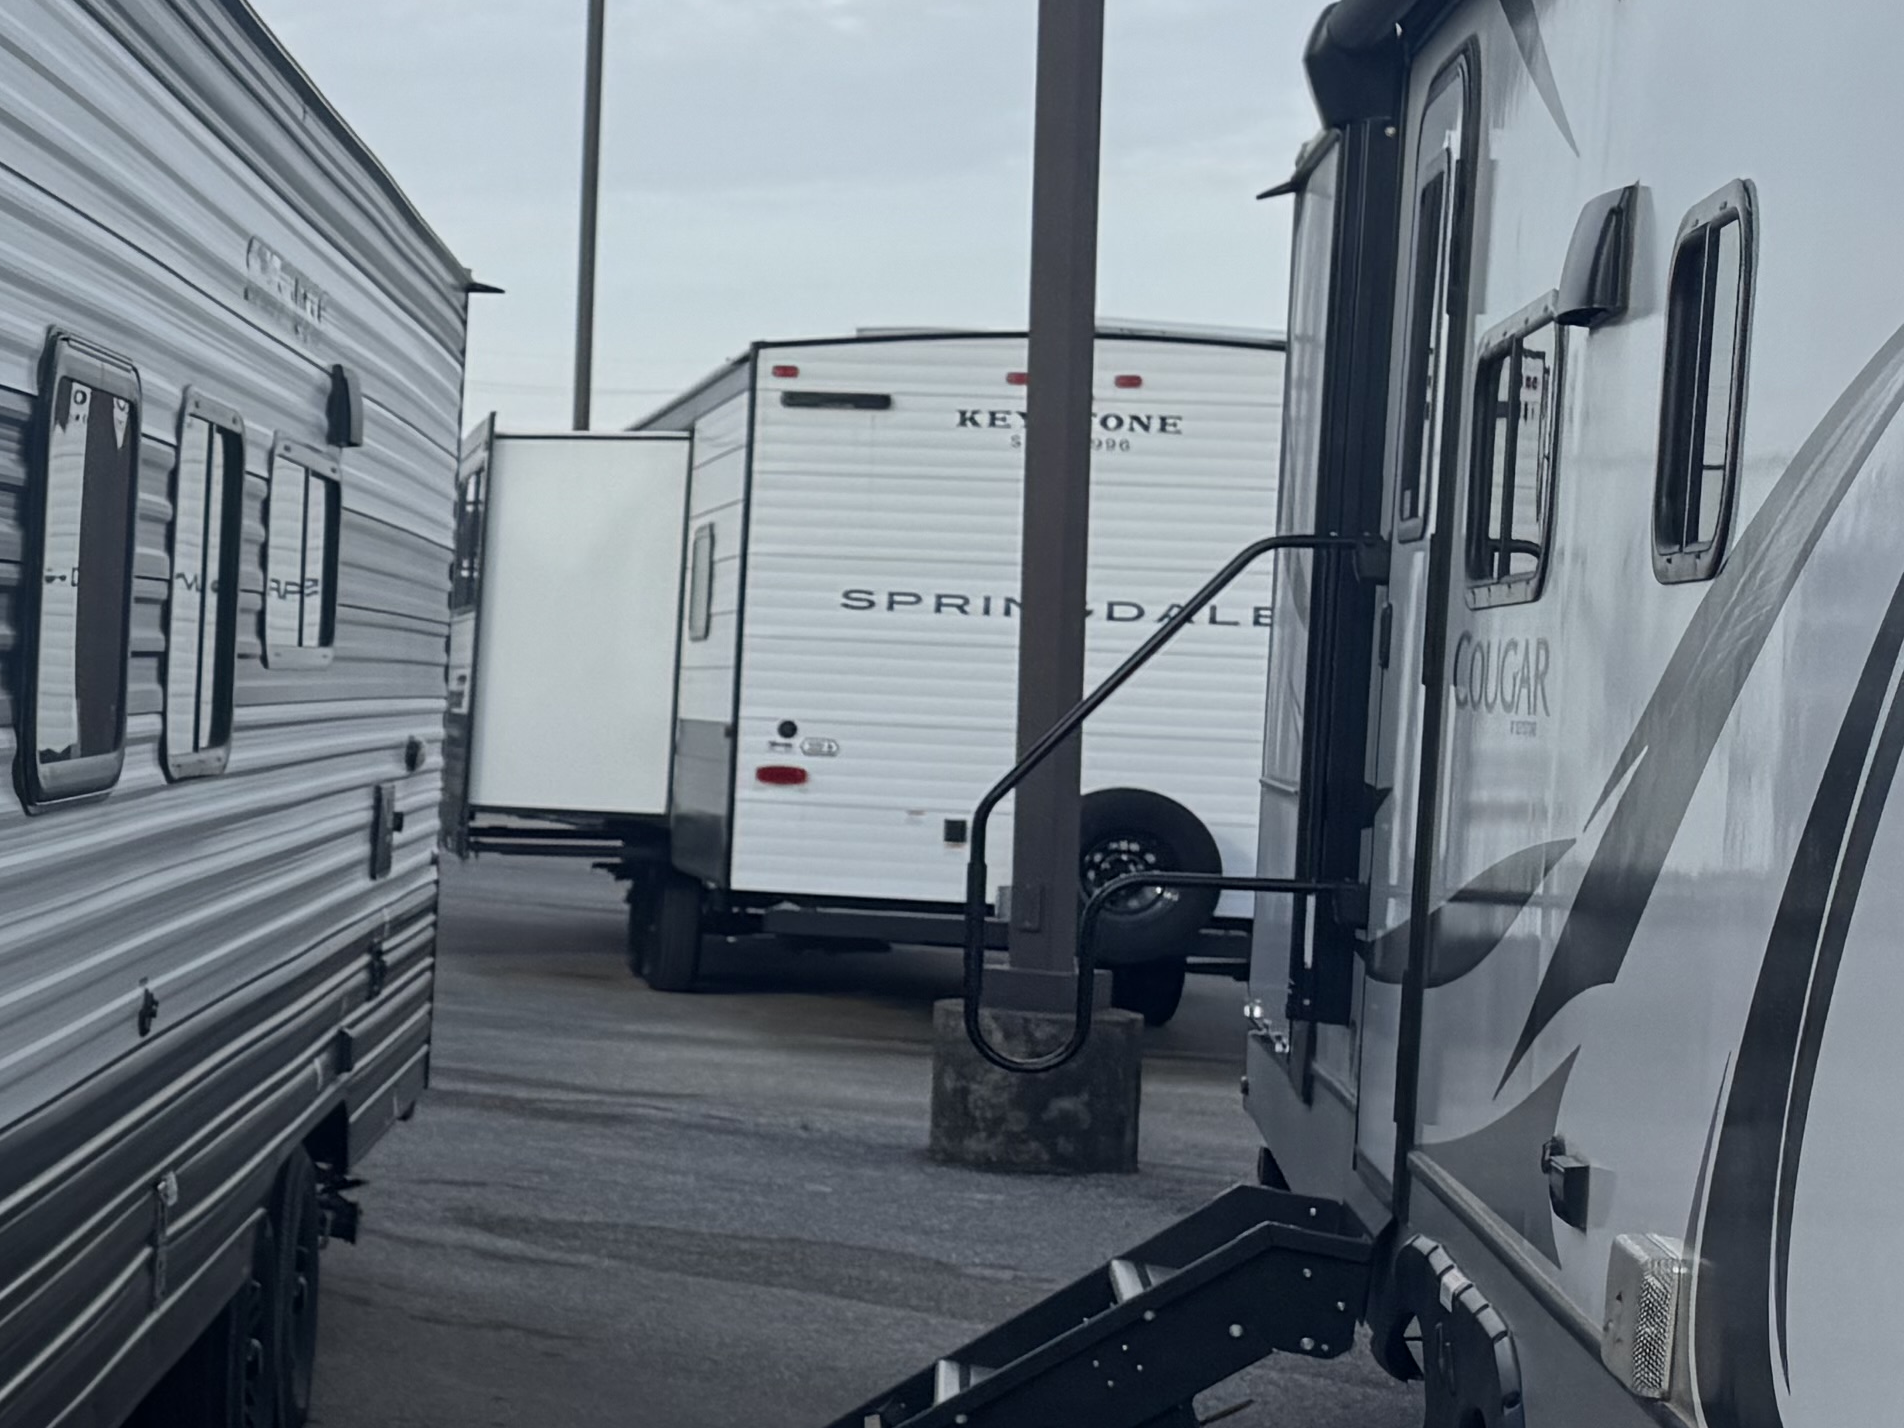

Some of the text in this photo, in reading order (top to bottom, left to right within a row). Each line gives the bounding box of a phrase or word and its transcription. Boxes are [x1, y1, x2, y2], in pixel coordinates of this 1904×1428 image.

[956, 409, 1184, 435] KEONE
[840, 588, 1273, 627] SPRINDALE
[1453, 630, 1551, 717] COUGAR
